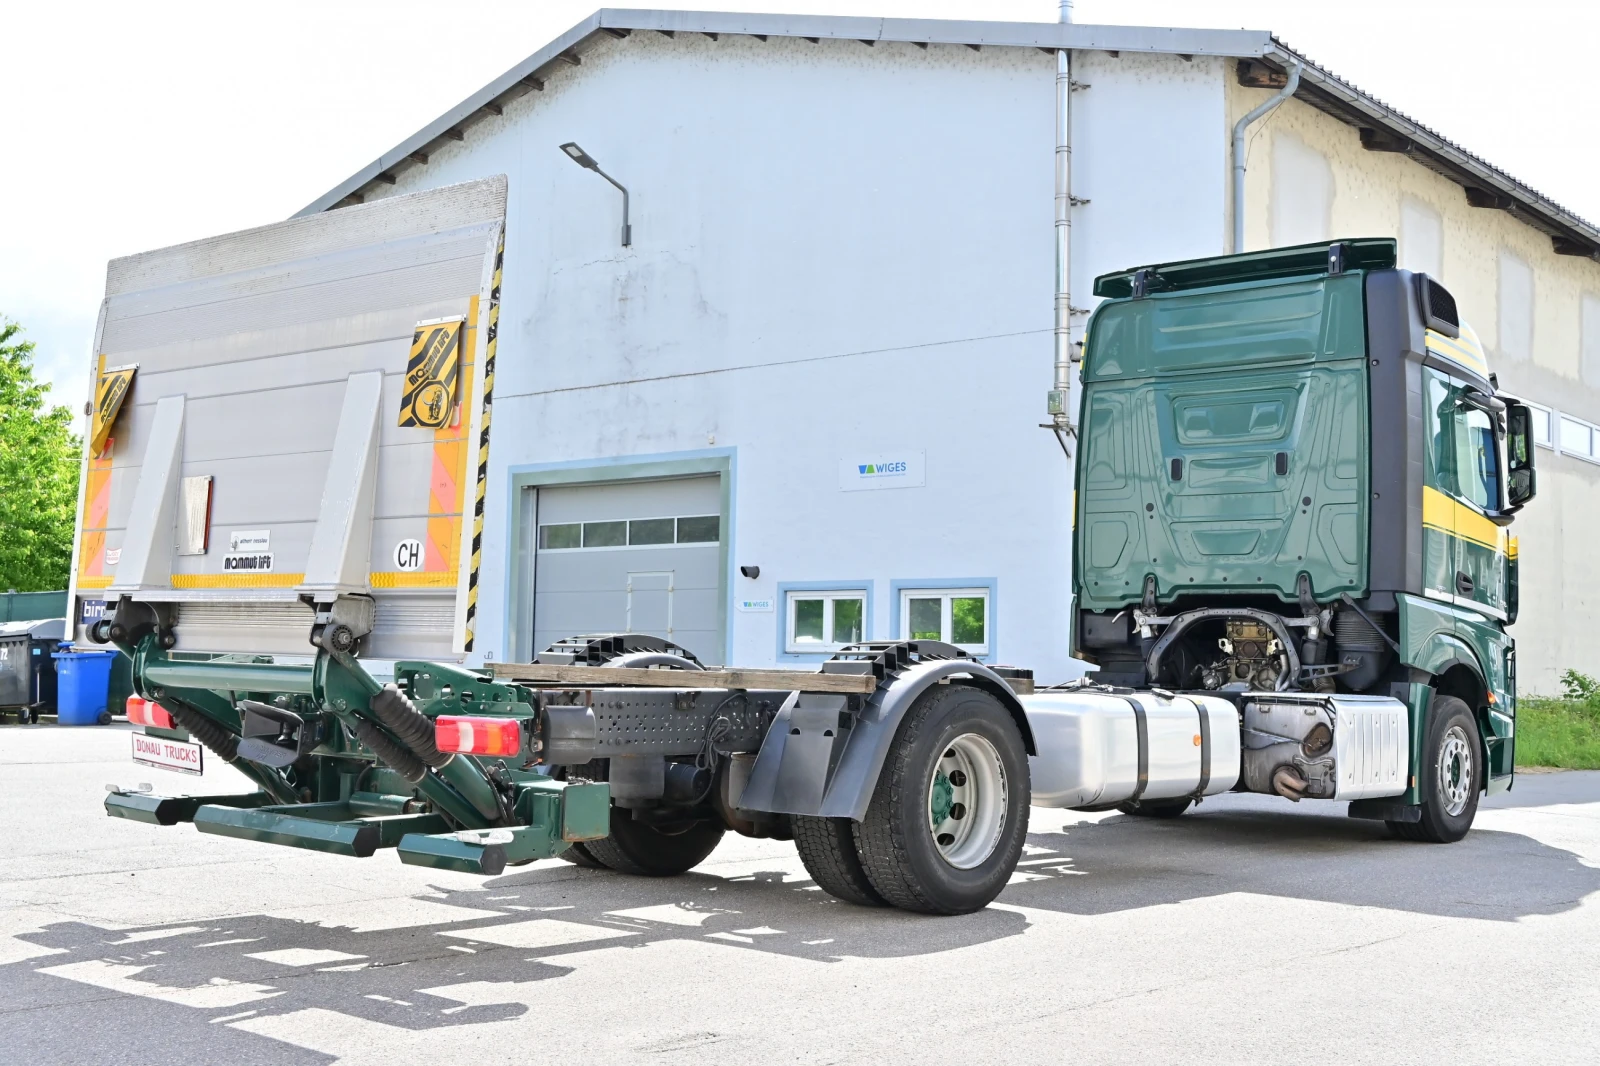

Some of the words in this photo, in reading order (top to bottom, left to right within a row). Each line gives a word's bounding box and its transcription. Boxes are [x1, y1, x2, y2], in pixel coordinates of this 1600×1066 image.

[876, 461, 907, 473] WIGES
[398, 543, 419, 567] CH
[136, 739, 161, 756] DONAU
[164, 744, 197, 763] TRUCKS
